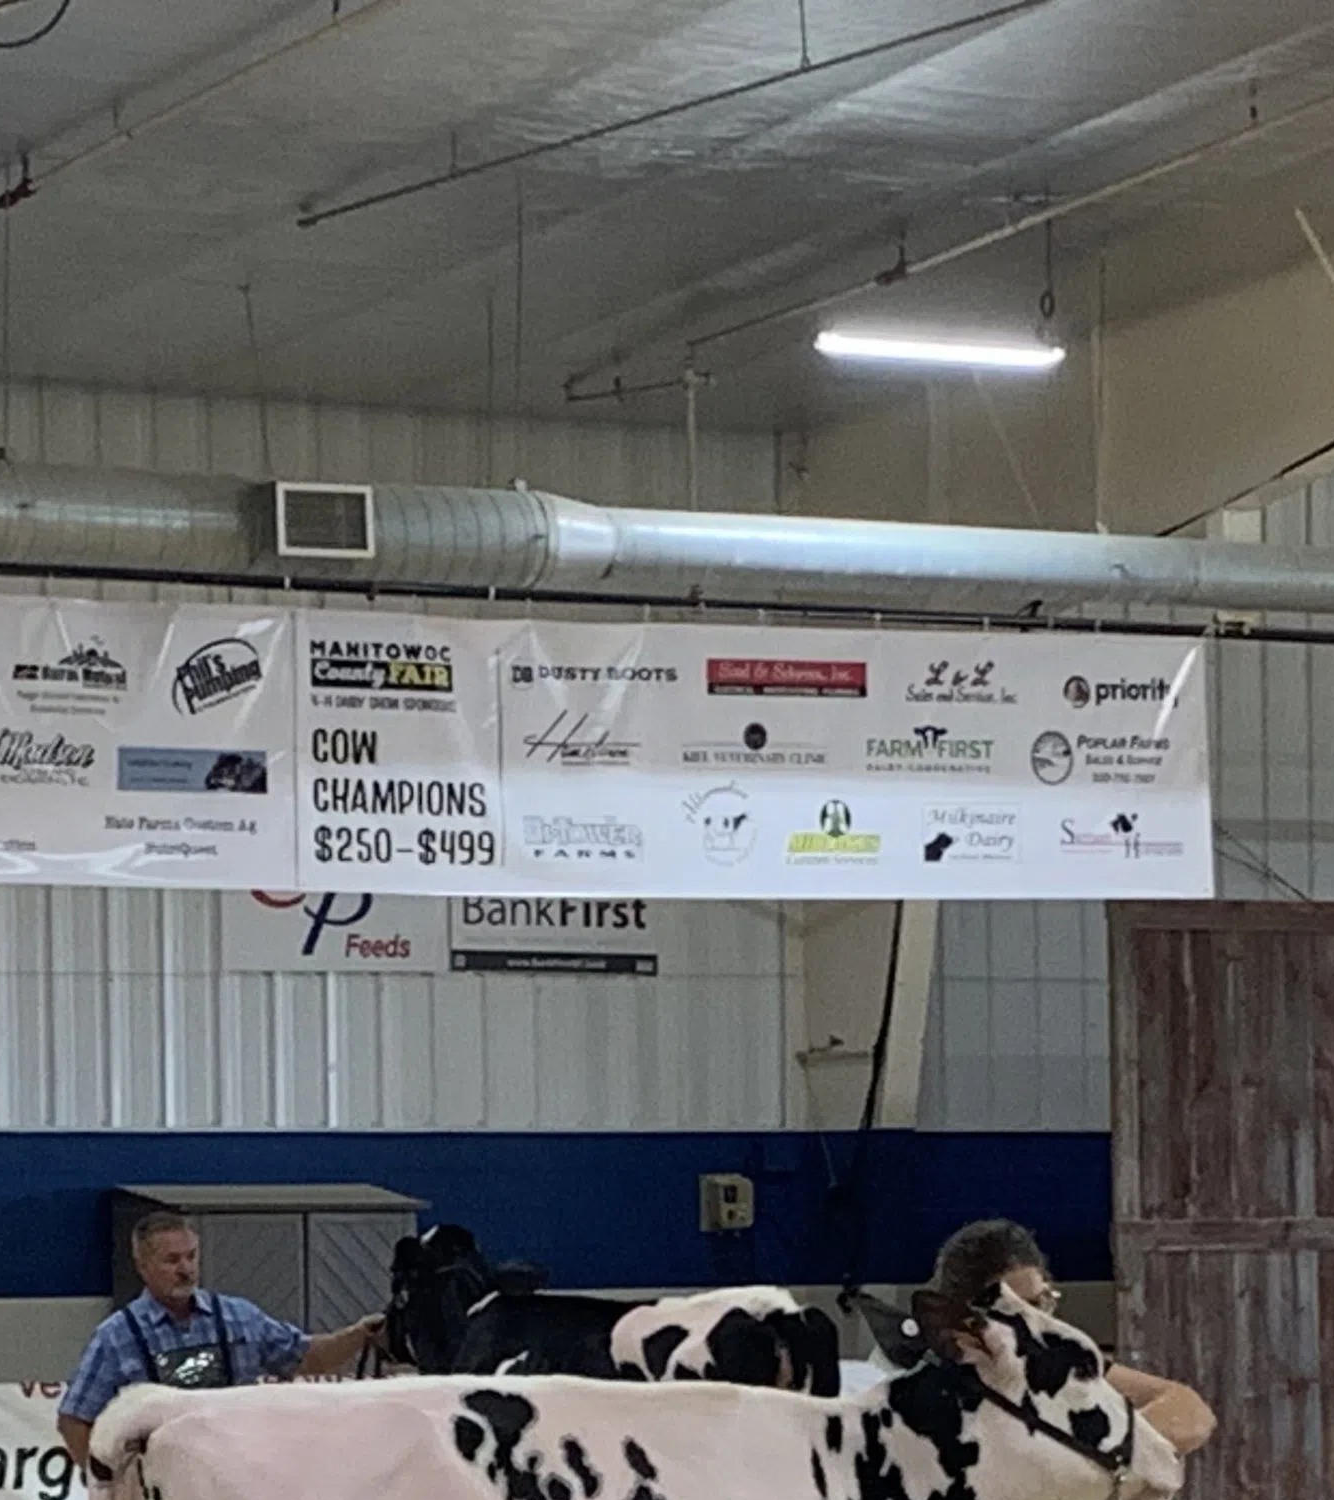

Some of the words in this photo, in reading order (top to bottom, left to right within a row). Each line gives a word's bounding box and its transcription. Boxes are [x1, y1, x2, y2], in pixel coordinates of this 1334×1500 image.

[310, 639, 450, 663] MANITOWOC
[315, 661, 385, 690] County
[385, 662, 450, 686] FAIR
[538, 665, 601, 682] DUSTY
[606, 666, 679, 682] BOOTS
[312, 728, 378, 765] COW
[866, 738, 924, 758] FARM
[937, 739, 994, 759] FIRST
[313, 777, 487, 817] CHAMPIONS
[138, 816, 181, 831] Farms
[314, 825, 495, 866] $250-$499
[967, 831, 1015, 852] Dairy
[345, 933, 411, 960] Feeds
